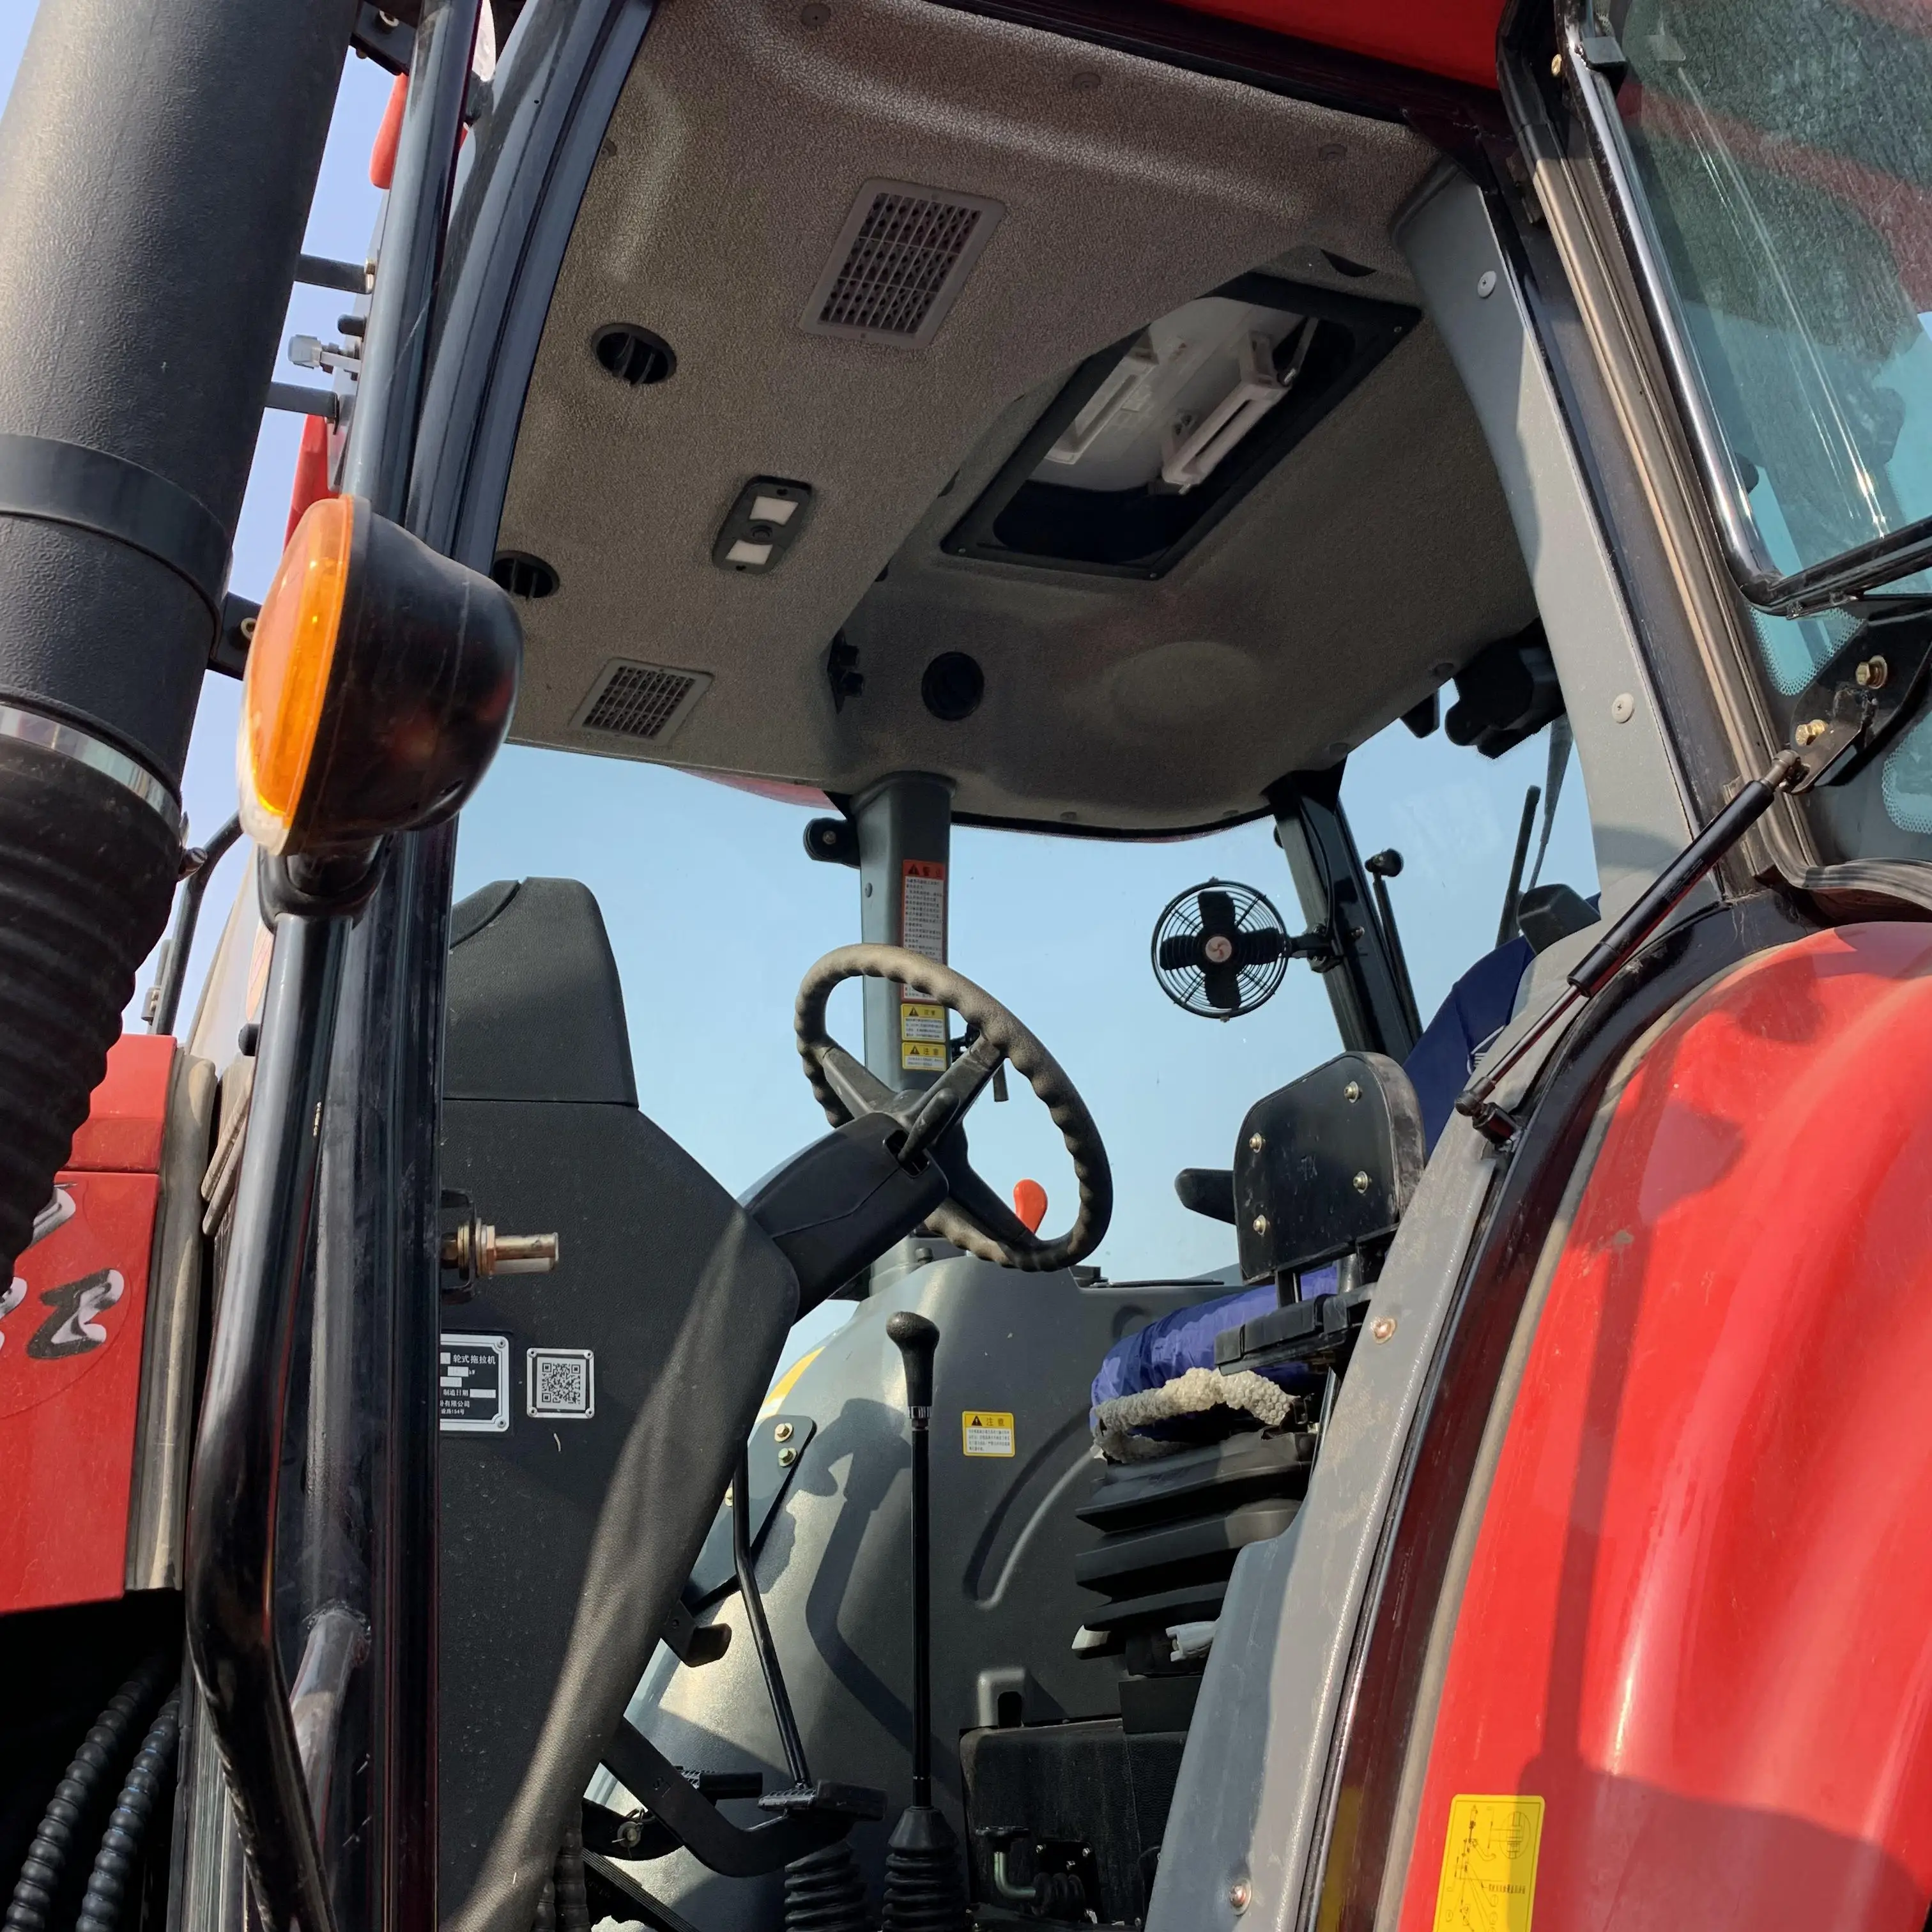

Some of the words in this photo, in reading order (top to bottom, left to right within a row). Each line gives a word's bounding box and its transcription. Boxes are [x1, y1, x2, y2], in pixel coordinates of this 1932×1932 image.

[453, 1354, 496, 1365] 轮式拖拉机
